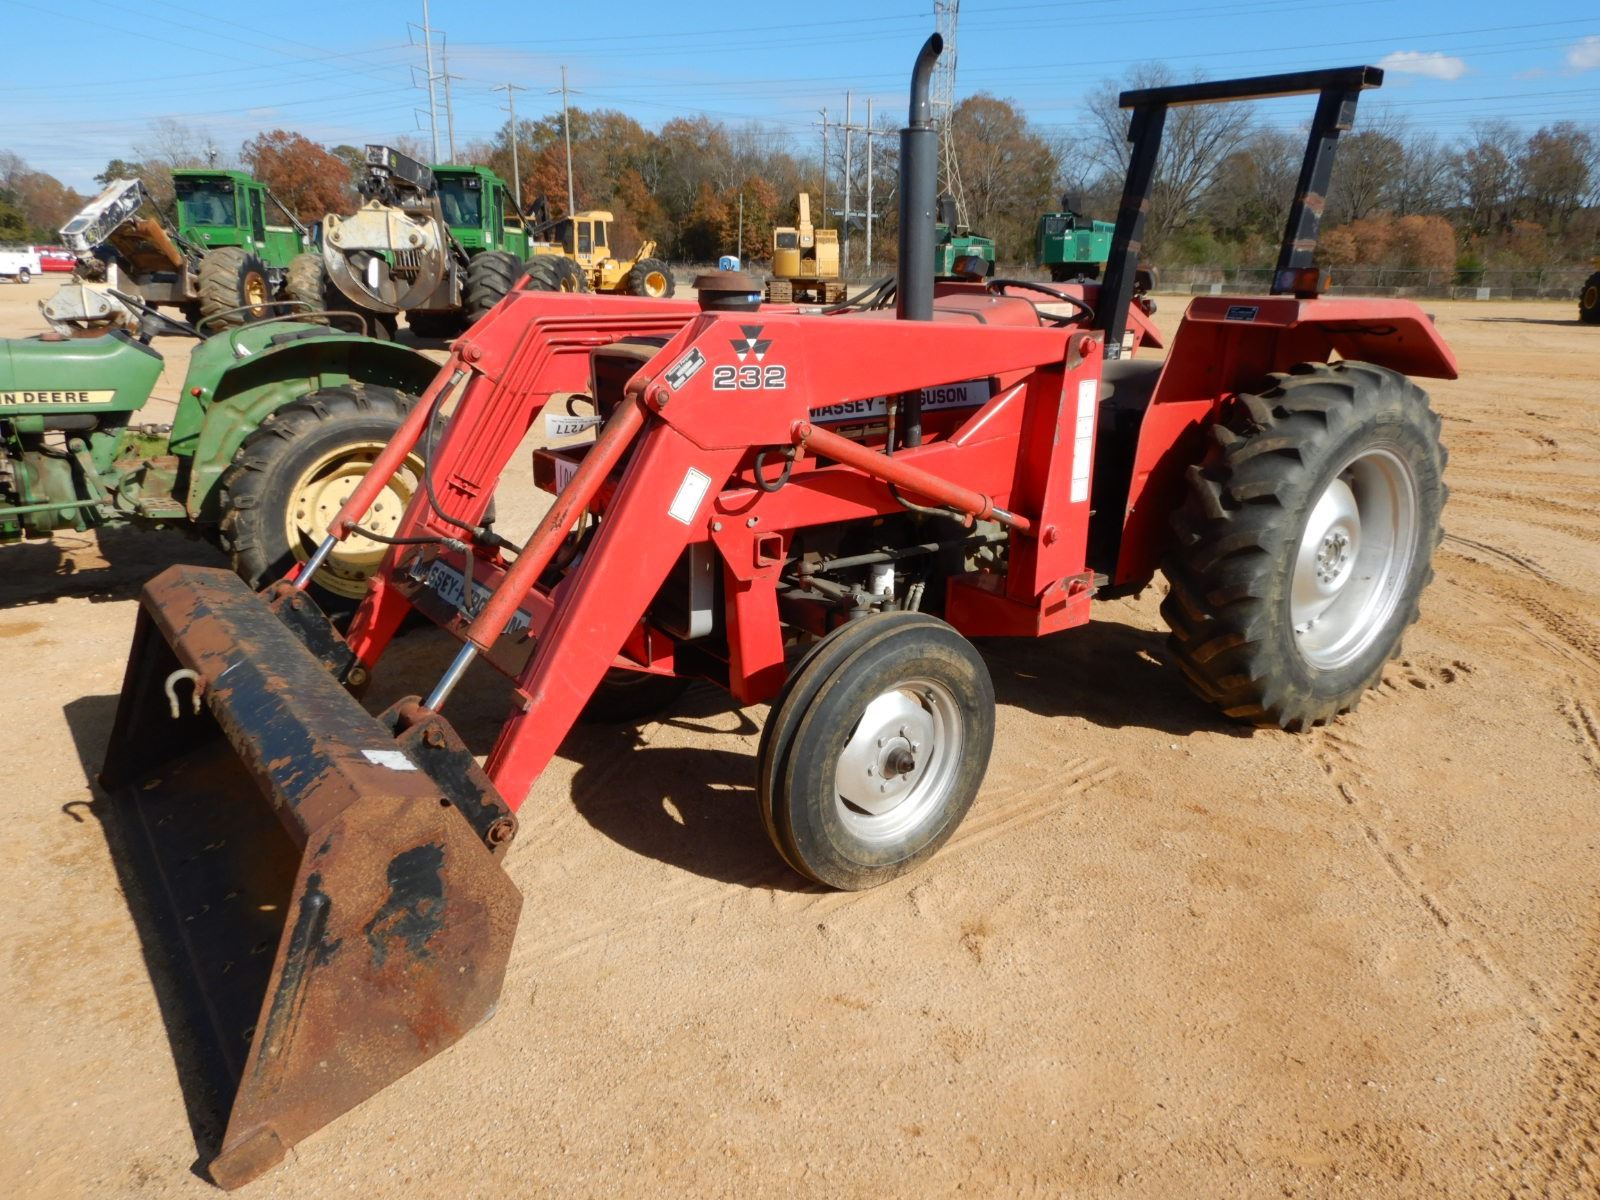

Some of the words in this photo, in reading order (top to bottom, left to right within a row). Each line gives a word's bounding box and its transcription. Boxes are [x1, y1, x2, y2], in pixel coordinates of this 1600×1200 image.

[712, 365, 786, 391] 232
[23, 392, 89, 403] DEERE
[556, 424, 585, 435] 7277
